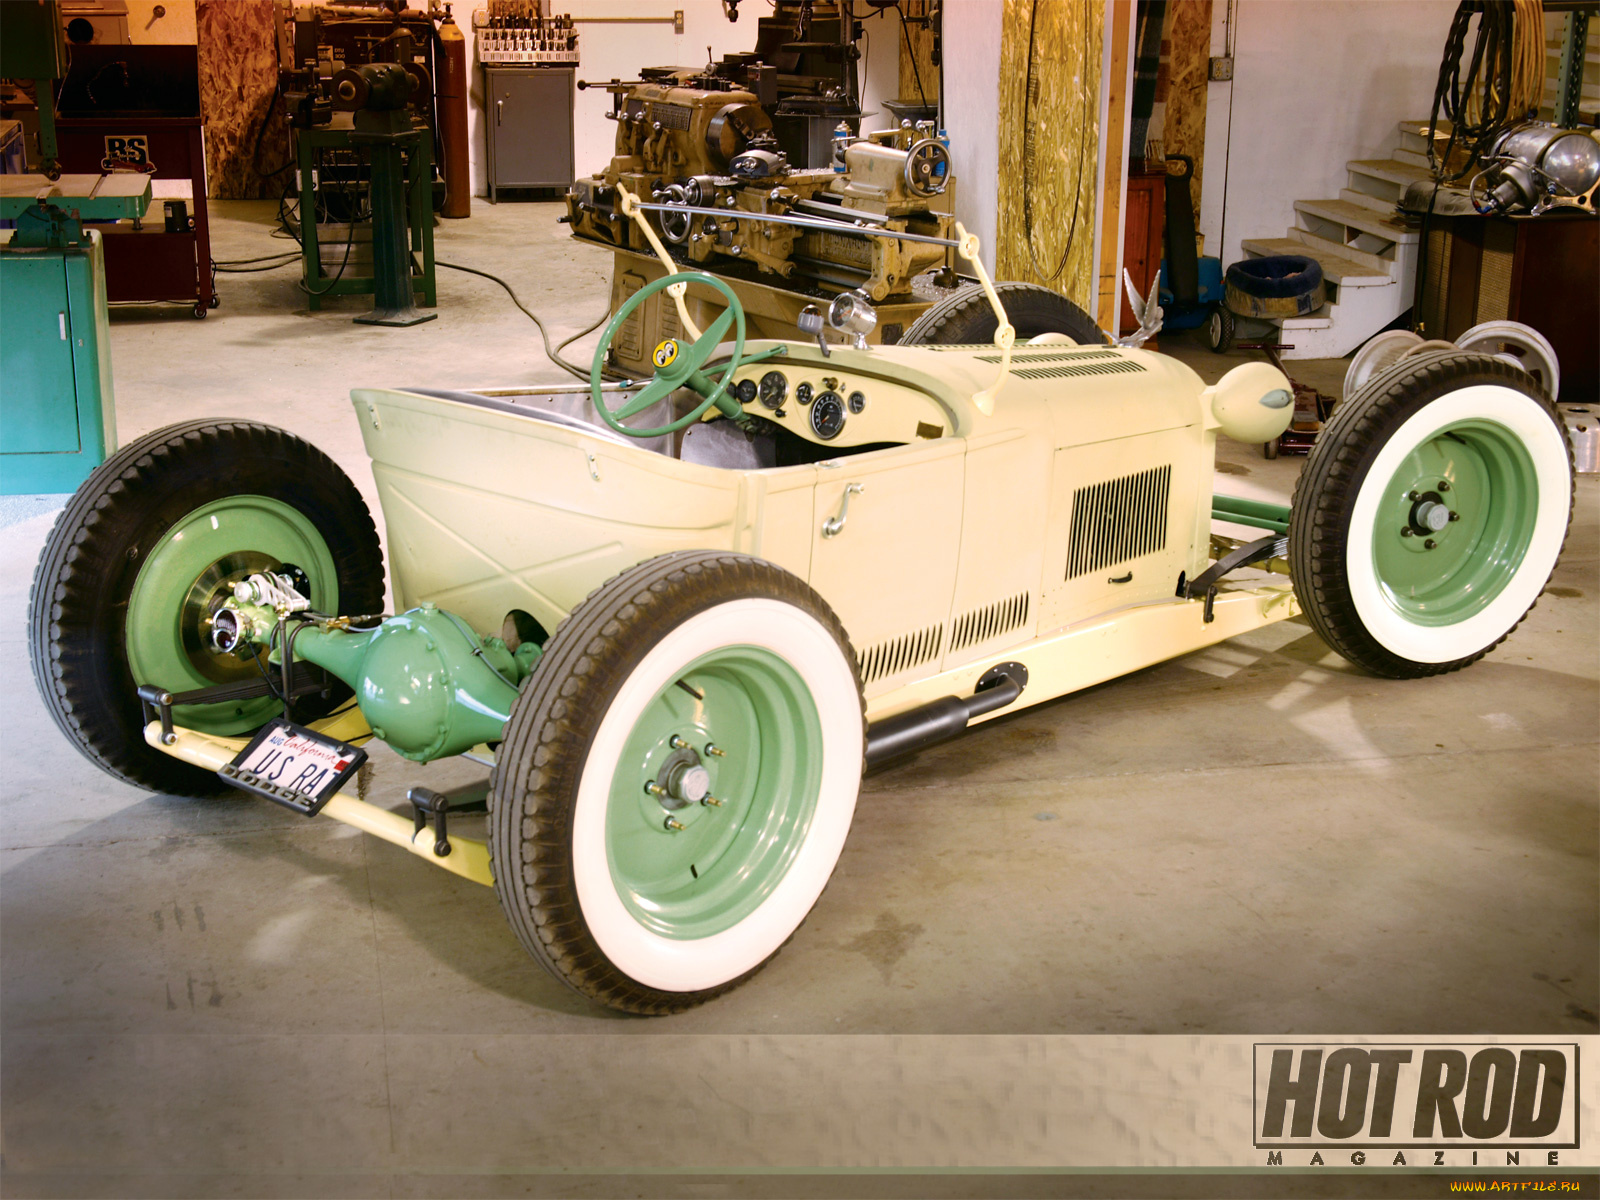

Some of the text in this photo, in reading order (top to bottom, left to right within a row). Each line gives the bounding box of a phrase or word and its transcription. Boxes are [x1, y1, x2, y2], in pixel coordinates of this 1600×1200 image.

[269, 736, 283, 746] AUG
[283, 734, 338, 764] California
[253, 749, 295, 781] US
[221, 764, 318, 806] DODGE
